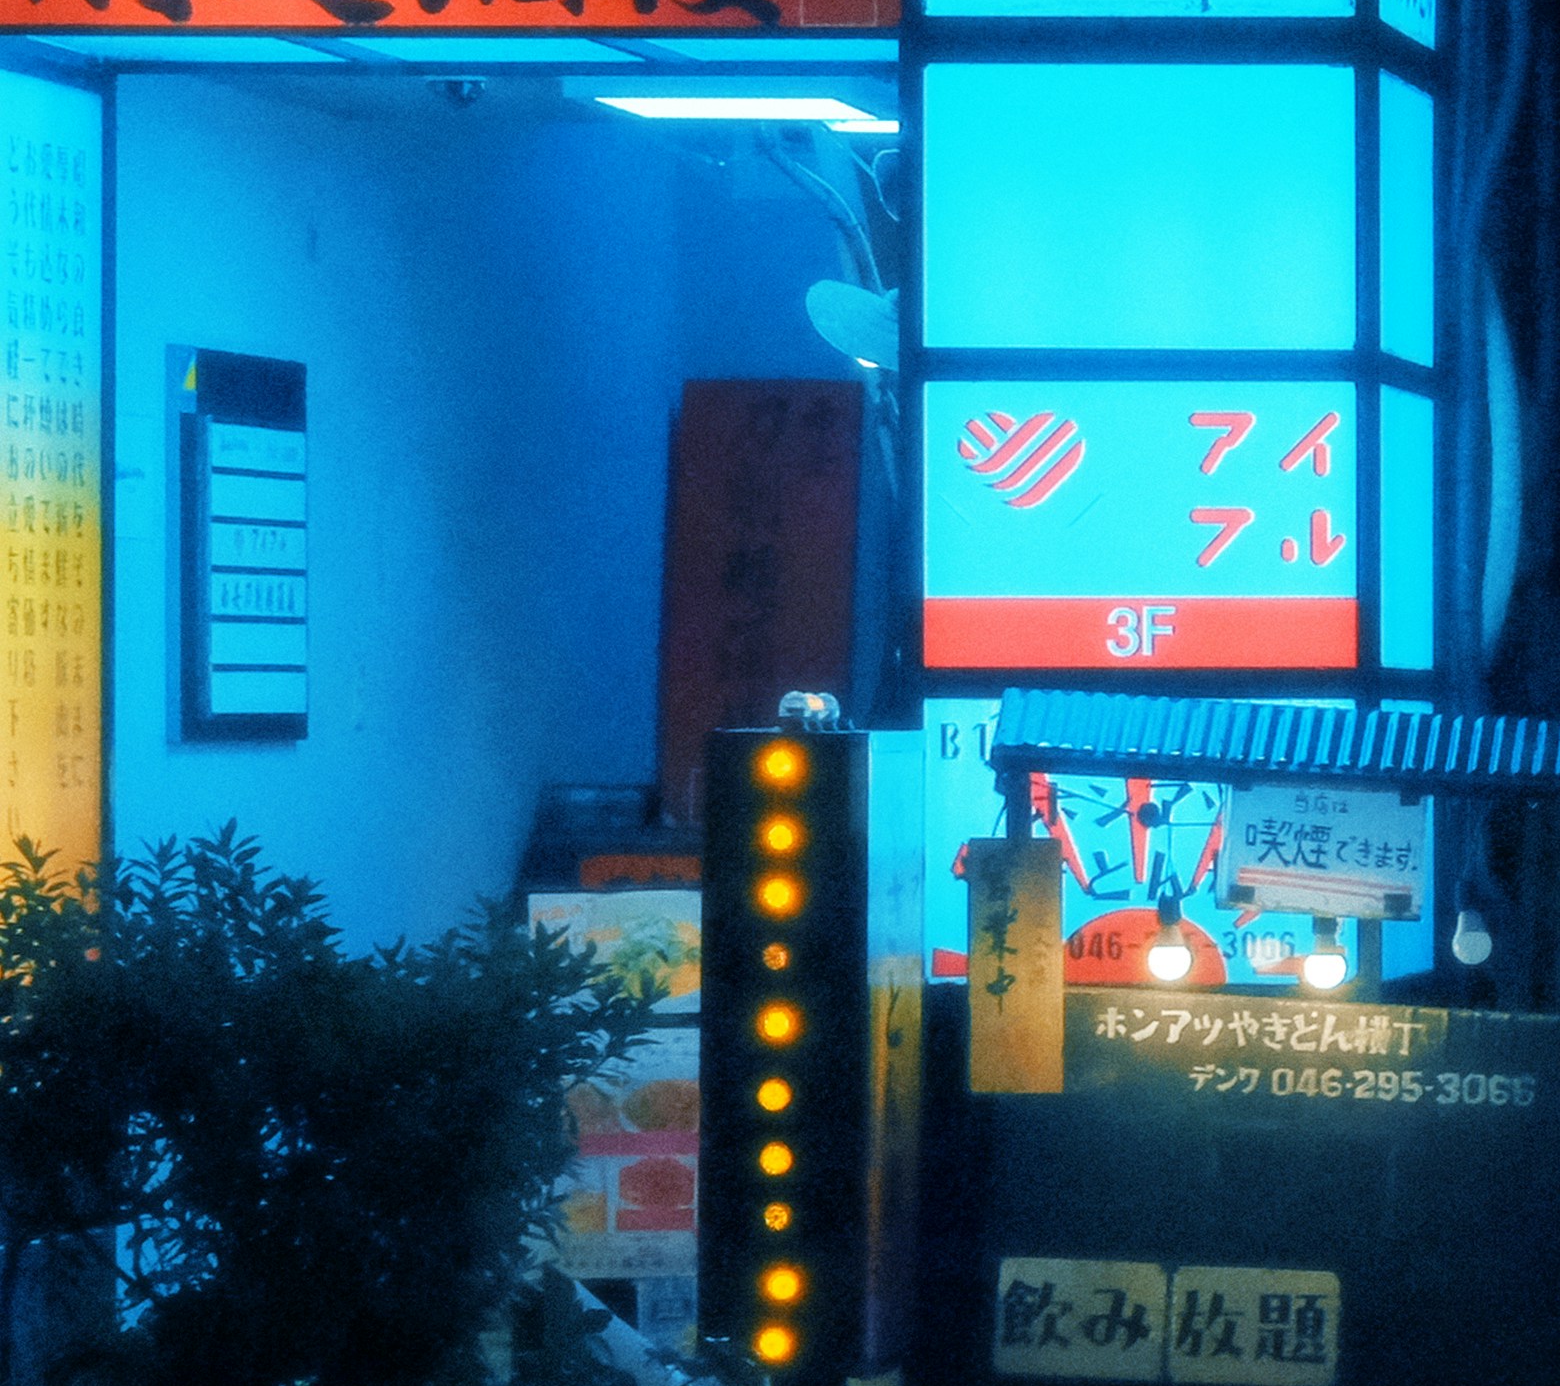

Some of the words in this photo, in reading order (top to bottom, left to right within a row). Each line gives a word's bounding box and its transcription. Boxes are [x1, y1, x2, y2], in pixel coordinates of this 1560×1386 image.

[1105, 606, 1178, 659] 3F
[1294, 793, 1349, 816] 当店は
[1001, 1277, 1332, 1366] 飲み放題
